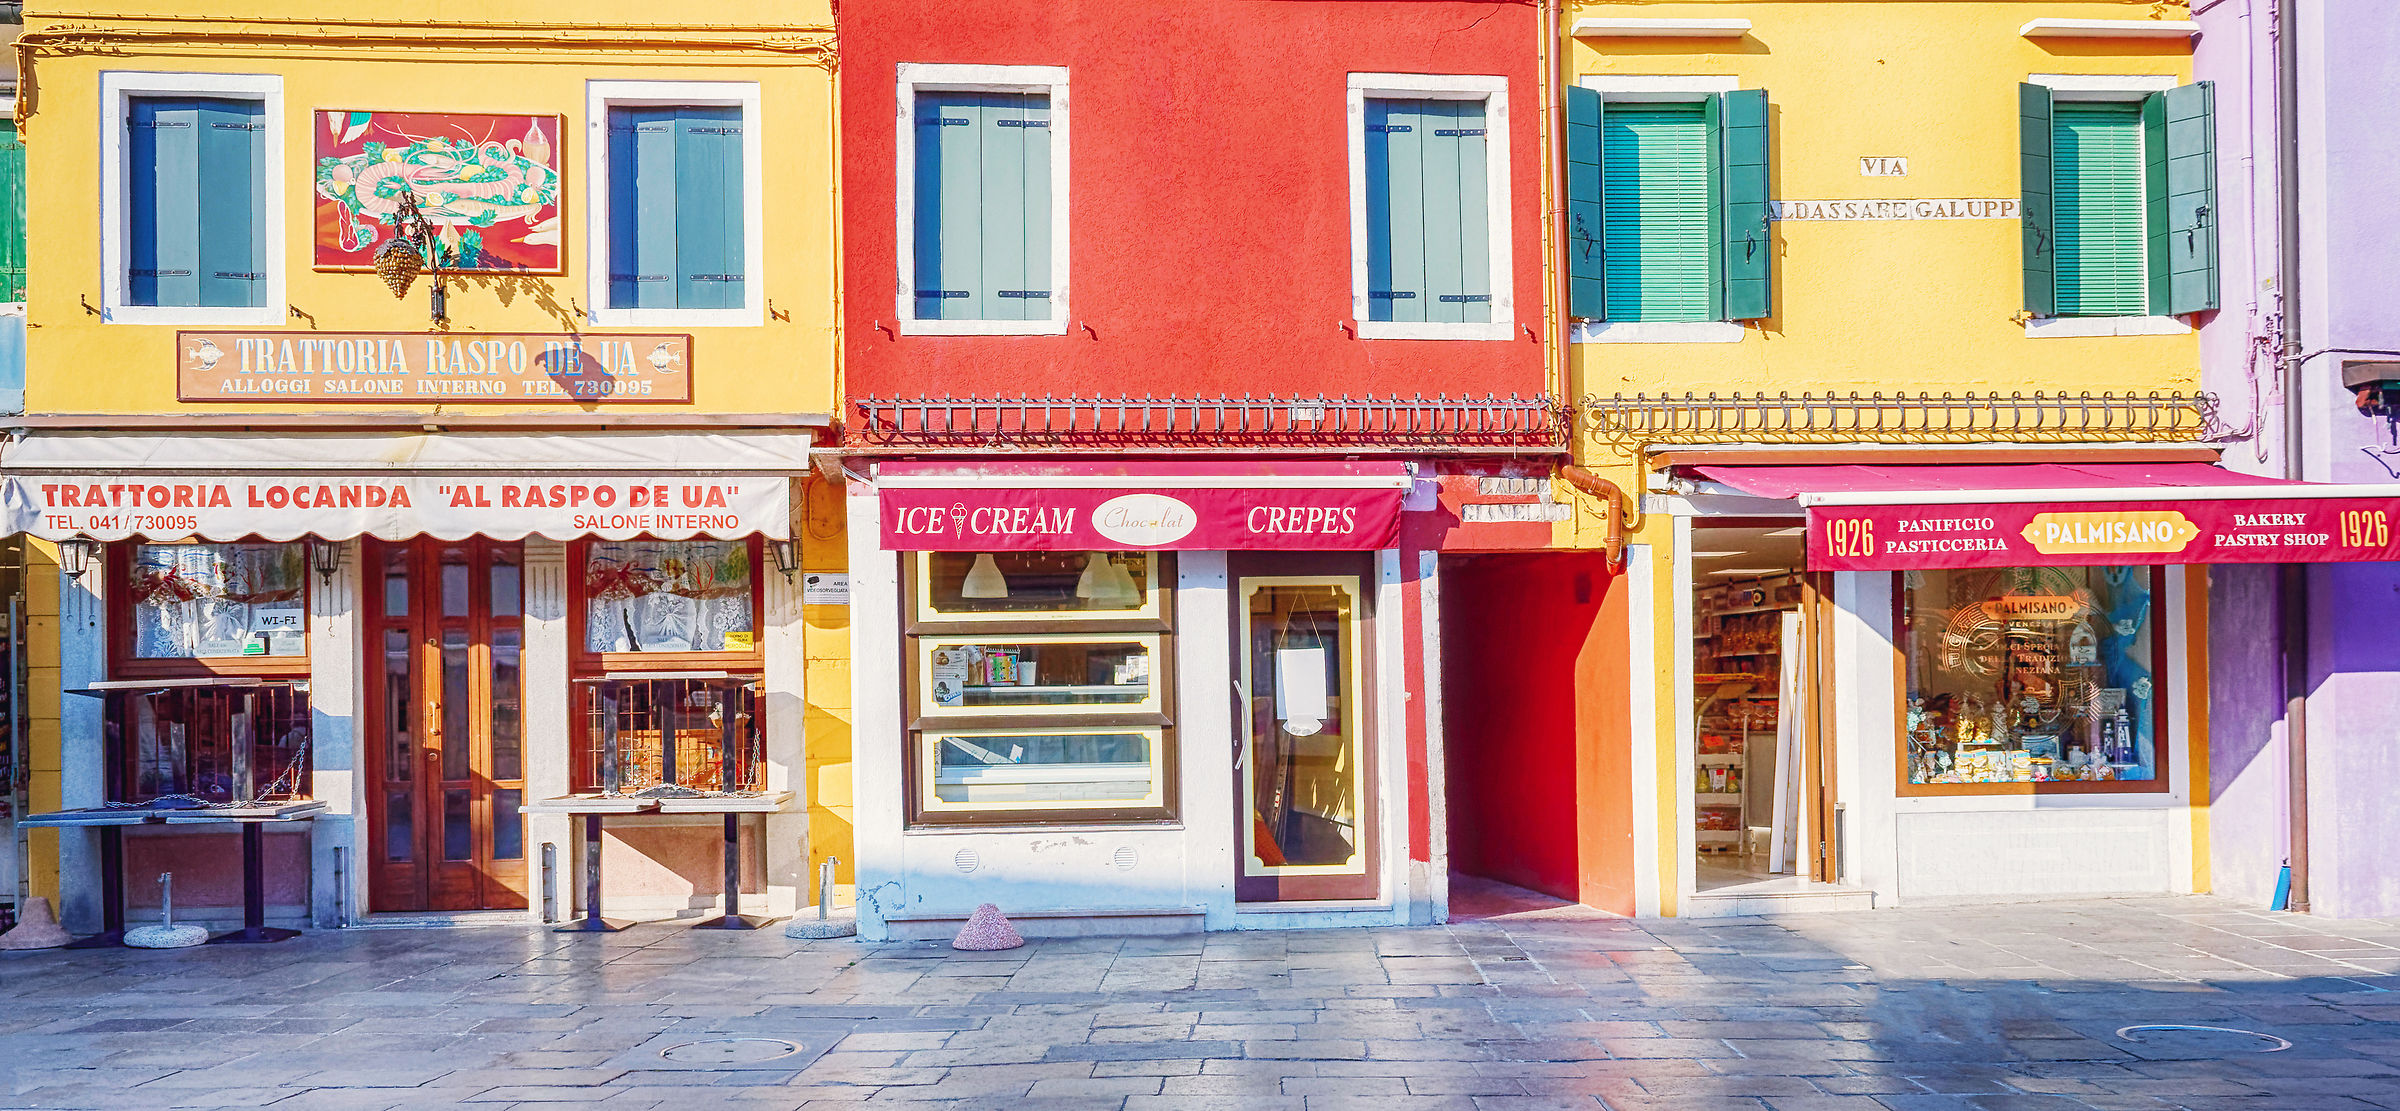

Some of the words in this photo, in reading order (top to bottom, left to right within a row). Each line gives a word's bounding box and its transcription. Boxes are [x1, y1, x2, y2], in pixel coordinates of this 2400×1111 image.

[1862, 158, 1905, 175] VIA
[236, 338, 410, 375] TRATTORIA
[426, 339, 528, 375] RASPO
[544, 341, 584, 376] DE
[600, 341, 639, 376] UA
[220, 378, 311, 394] ALLOGGI
[324, 379, 403, 394] SALONE
[416, 379, 507, 395] INTERNO
[522, 380, 568, 395] TEL.
[573, 380, 652, 395] 730095
[41, 484, 232, 508] TRATTORIA
[248, 484, 412, 509] LOCANDA
[439, 485, 491, 508] "AL
[502, 484, 617, 508] RASPO
[629, 485, 669, 508] DE
[681, 485, 739, 508] UA"
[45, 515, 84, 530] TEL.
[573, 514, 650, 530] SALONE
[656, 514, 739, 530] INTERNO
[894, 506, 946, 534] ICE
[970, 506, 1076, 535] CREAM
[1247, 506, 1357, 535] CREPES
[1898, 517, 1995, 533] PANIFICIO
[2233, 513, 2307, 527] BAKERY
[1826, 518, 1874, 557] 1926
[2046, 521, 2173, 545] PALMISANO
[2340, 510, 2388, 548] 1926
[1885, 538, 2009, 554] PASTICCERIA
[2214, 533, 2281, 547] PASTRY
[2283, 533, 2330, 547] SHOP
[1995, 601, 2067, 614] PALMISANO
[261, 616, 297, 626] WI-FI
